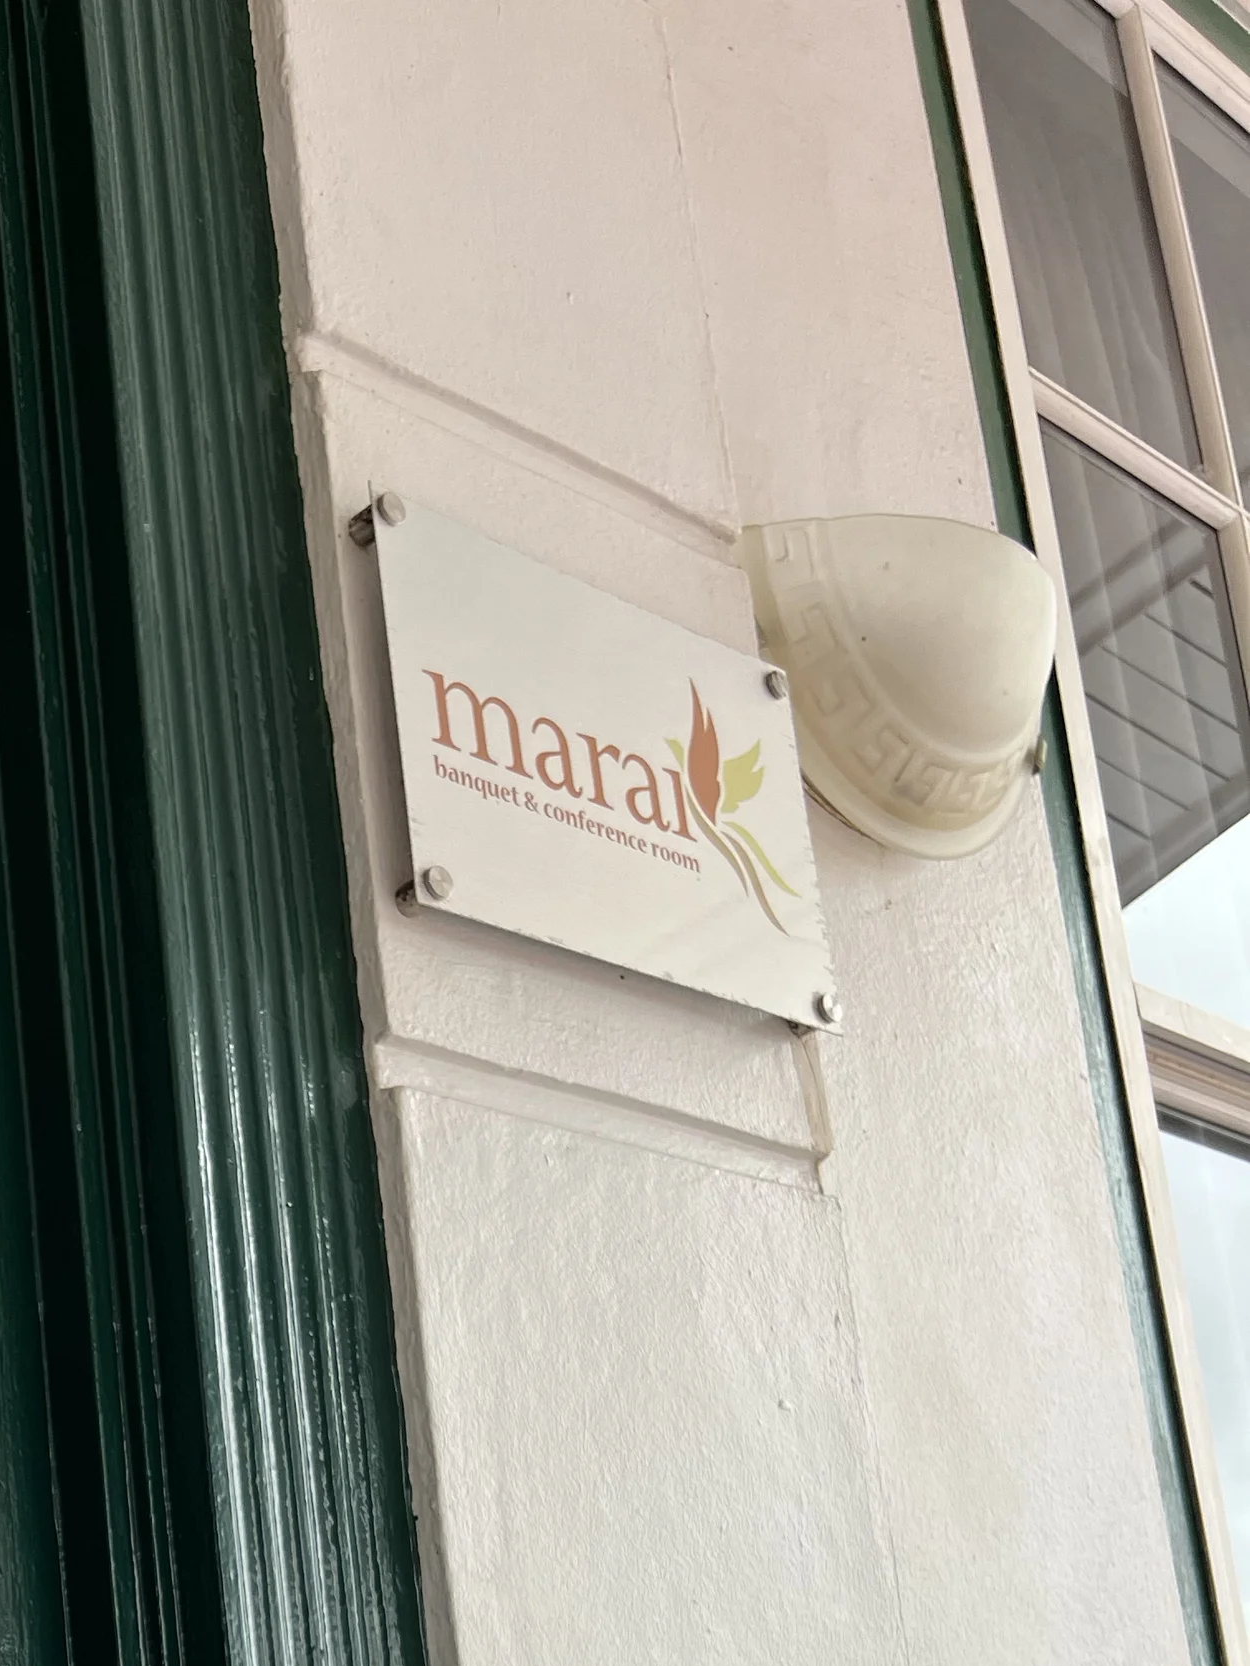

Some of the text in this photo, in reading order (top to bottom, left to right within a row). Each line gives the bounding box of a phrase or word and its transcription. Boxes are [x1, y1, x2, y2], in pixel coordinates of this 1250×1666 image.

[433, 755, 701, 873] banquet & conference room
